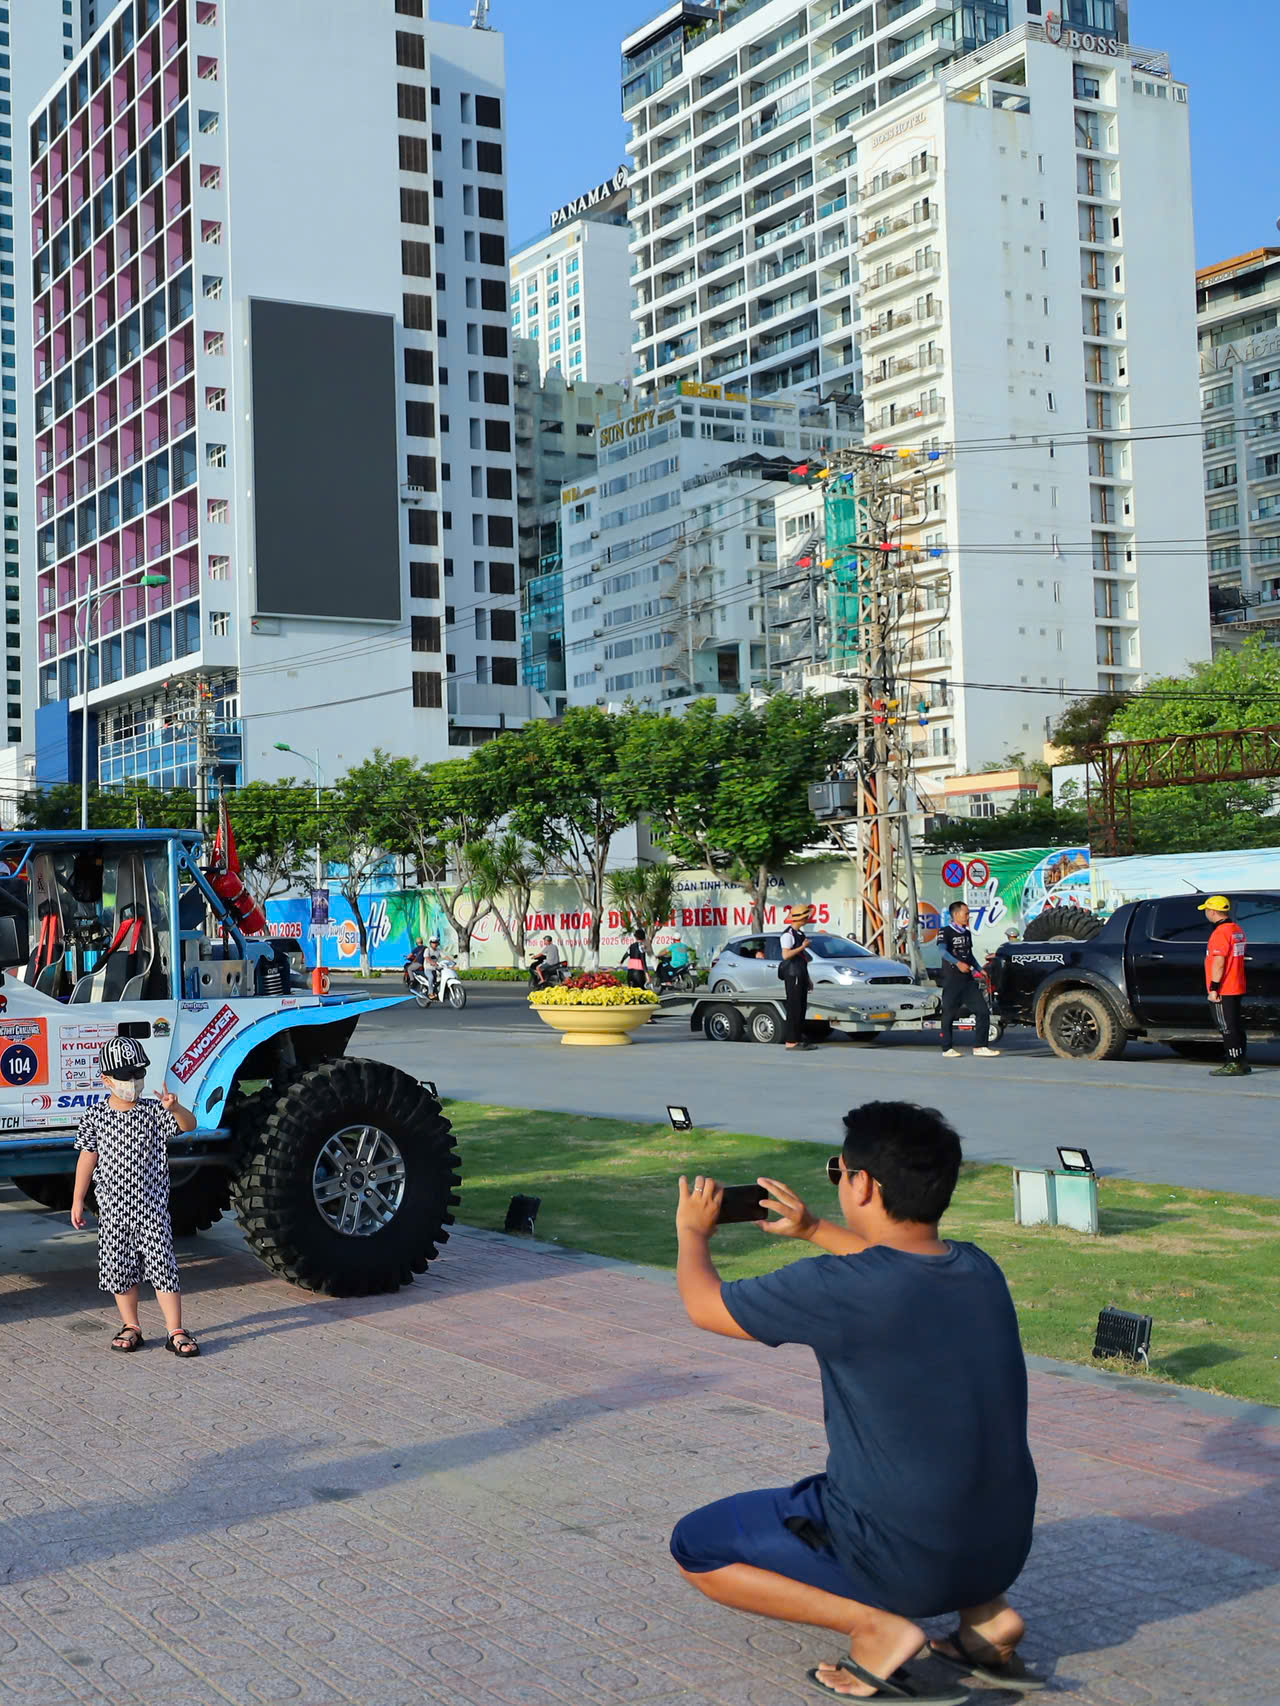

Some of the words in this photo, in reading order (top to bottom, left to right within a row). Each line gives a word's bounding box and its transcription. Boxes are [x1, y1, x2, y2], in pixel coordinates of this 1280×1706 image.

[1068, 31, 1118, 56] BOSS
[895, 112, 927, 138] HOTEL
[551, 182, 611, 228] PANAMA
[600, 421, 625, 448] SUN
[625, 409, 656, 437] CITY
[525, 909, 556, 931] VĂN
[682, 898, 728, 927] BIỂN
[279, 922, 302, 938] 2025
[1011, 953, 1065, 966] RAPTOR
[187, 1009, 235, 1059] WOLVER
[8, 1057, 31, 1075] 104
[74, 1058, 86, 1066] MB
